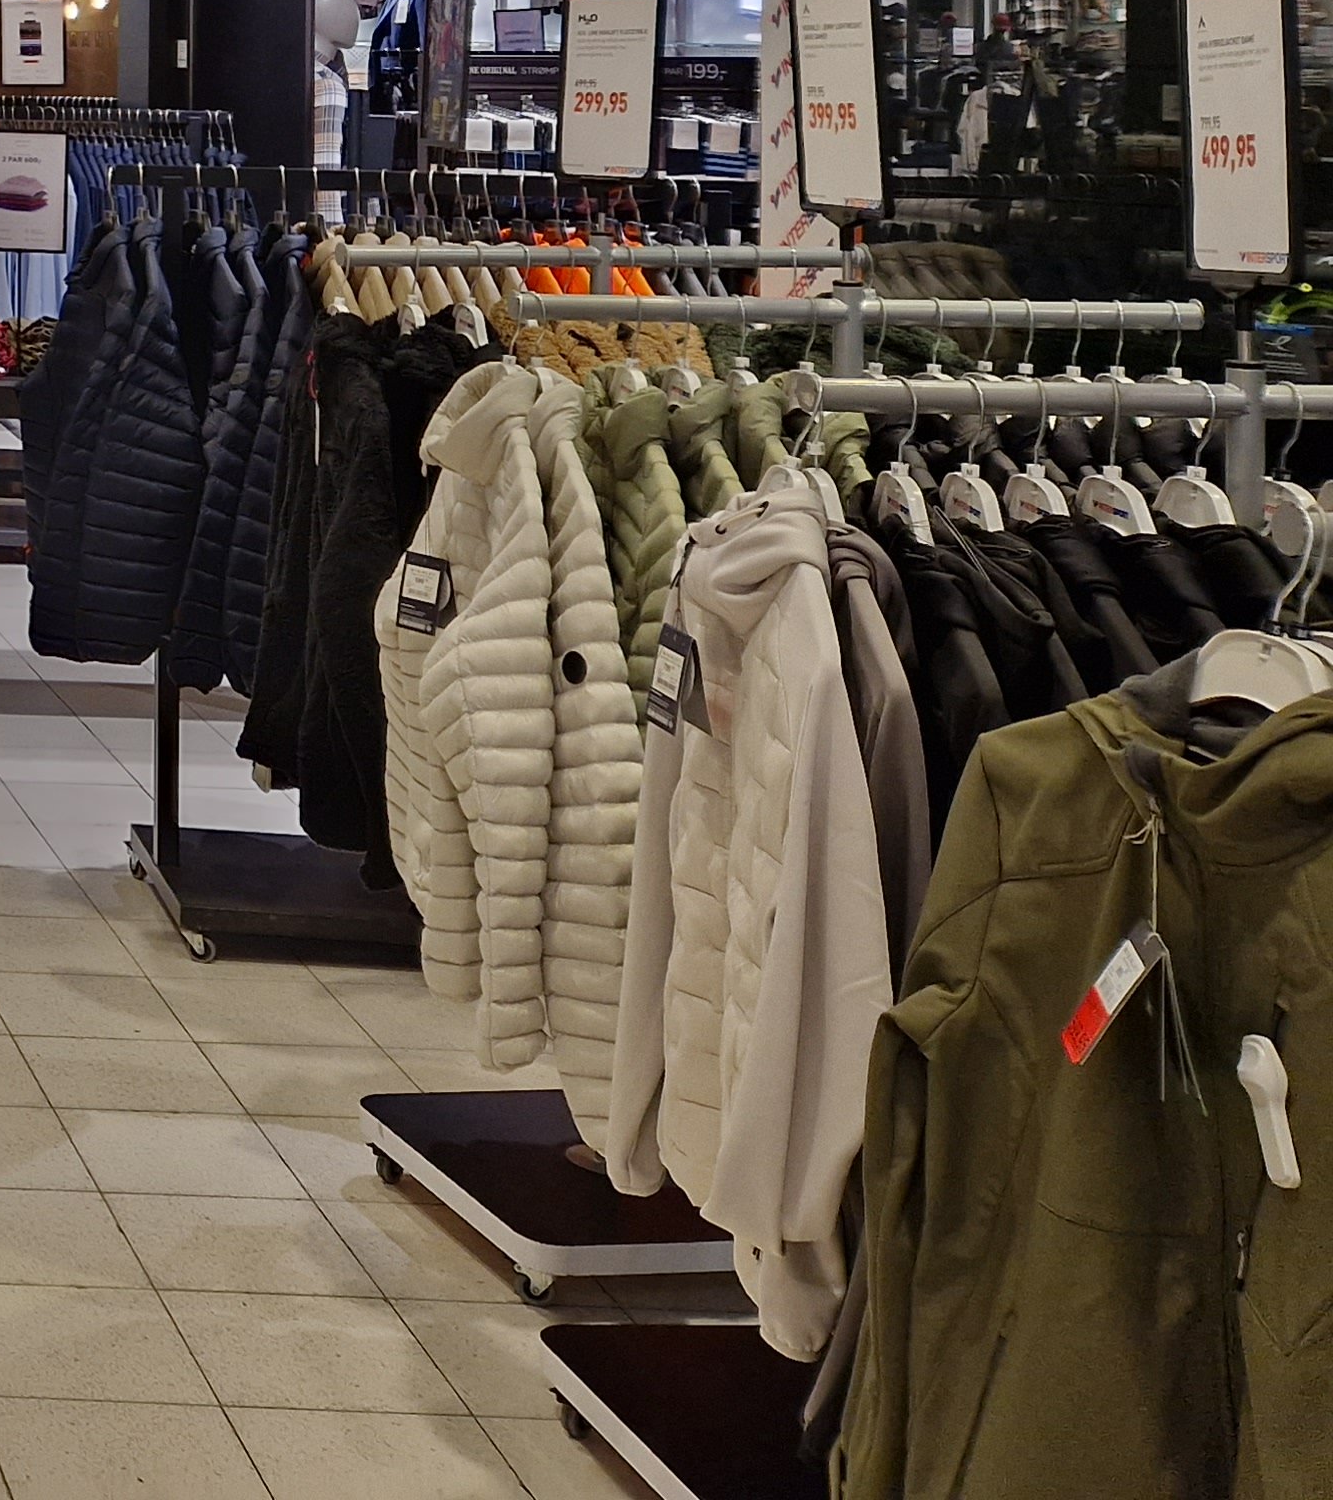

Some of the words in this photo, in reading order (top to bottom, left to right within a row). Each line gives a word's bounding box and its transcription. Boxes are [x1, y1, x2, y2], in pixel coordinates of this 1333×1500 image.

[520, 66, 560, 75] STRØMP
[574, 91, 628, 116] 299,95
[808, 102, 858, 134] 399,95
[1201, 134, 1257, 174] 499,95
[609, 166, 648, 176] INTERSPOR
